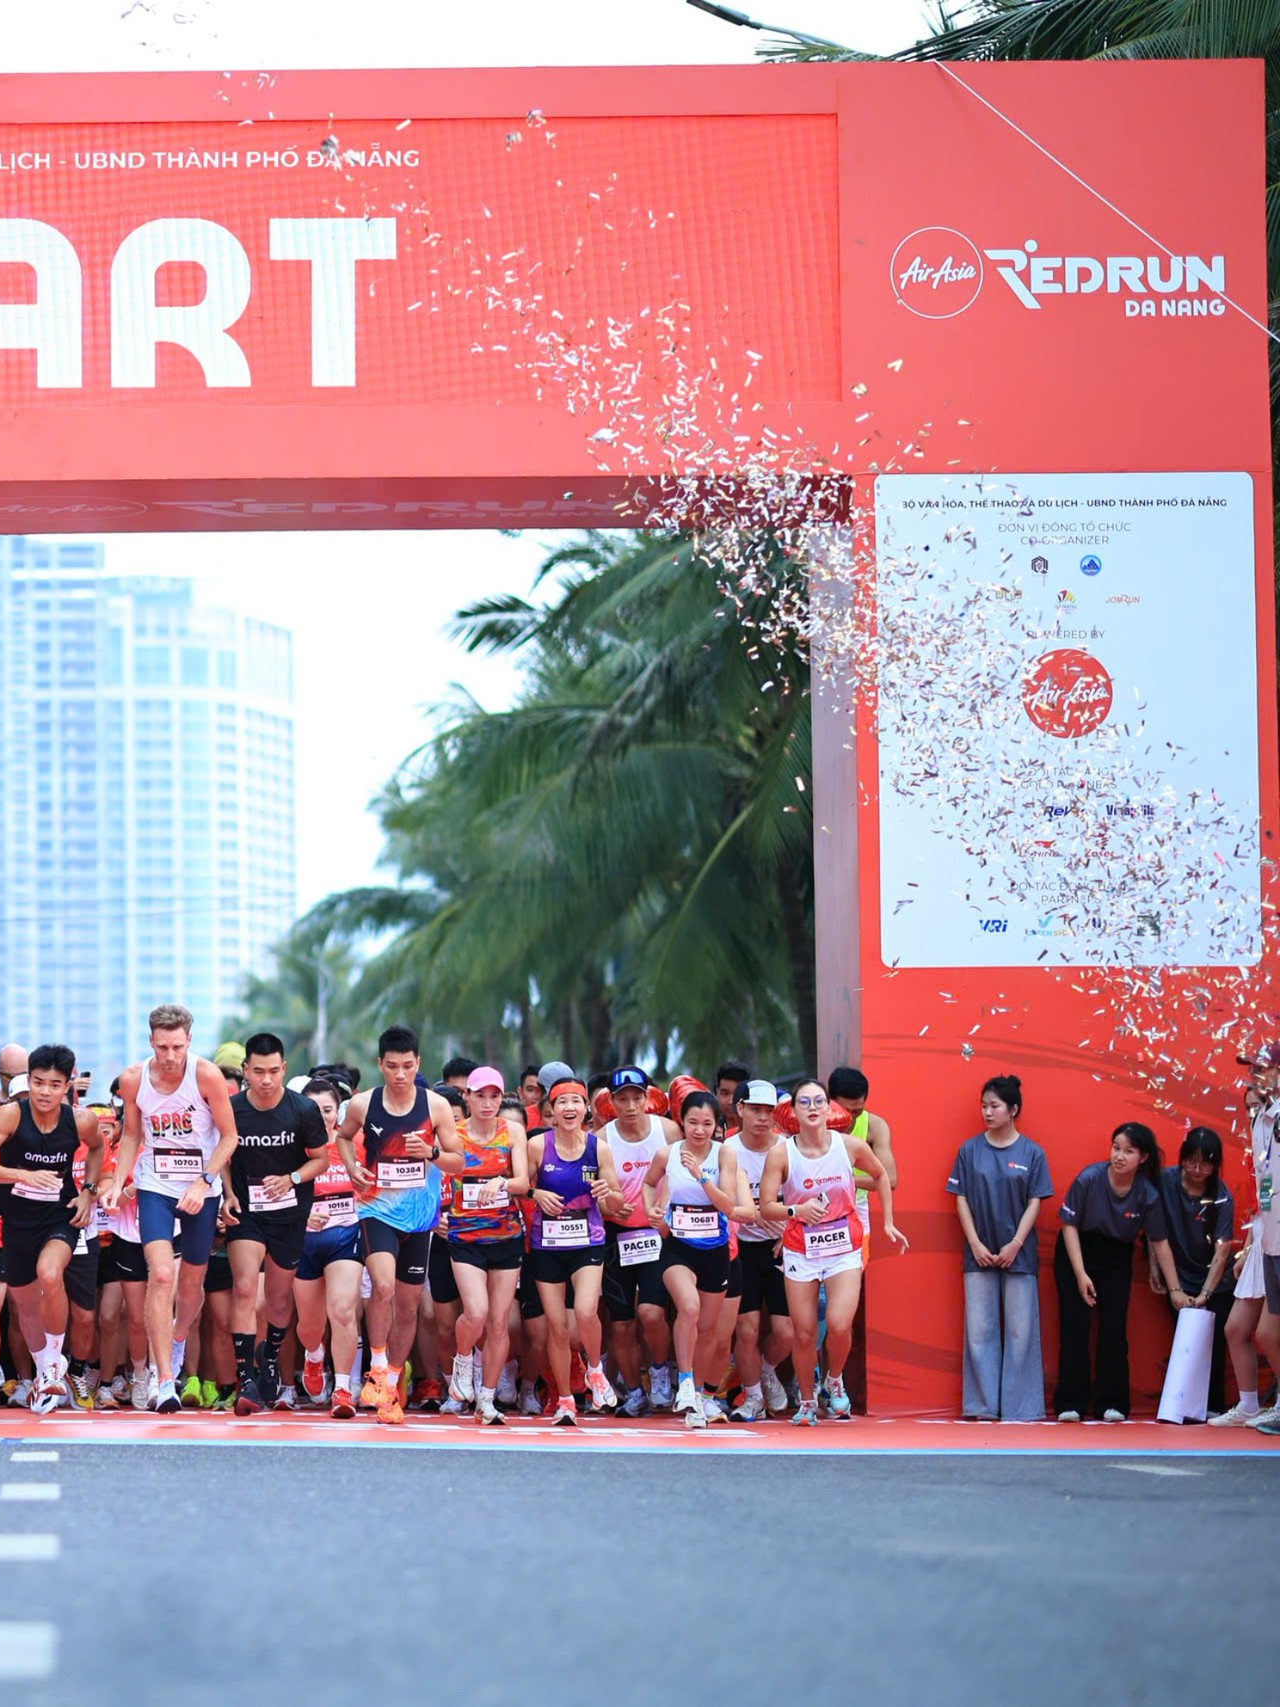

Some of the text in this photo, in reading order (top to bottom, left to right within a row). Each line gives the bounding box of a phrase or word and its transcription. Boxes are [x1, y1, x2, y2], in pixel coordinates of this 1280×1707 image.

[75, 151, 145, 169] UBND
[152, 146, 238, 169] THÀNH
[246, 145, 299, 168] PHỐ
[982, 248, 1226, 310] REDRUN
[1125, 298, 1227, 317] DA NANG
[1087, 499, 1116, 508] UBND
[237, 1130, 296, 1147] amazfit
[24, 1151, 68, 1164] amazfit
[173, 1159, 199, 1167] 10703
[395, 1166, 422, 1174] 10384
[328, 1201, 350, 1209] 10156
[690, 1216, 715, 1224] 10681
[560, 1223, 584, 1232] 10551
[810, 1231, 846, 1245] PACER
[623, 1239, 657, 1252] PACER
